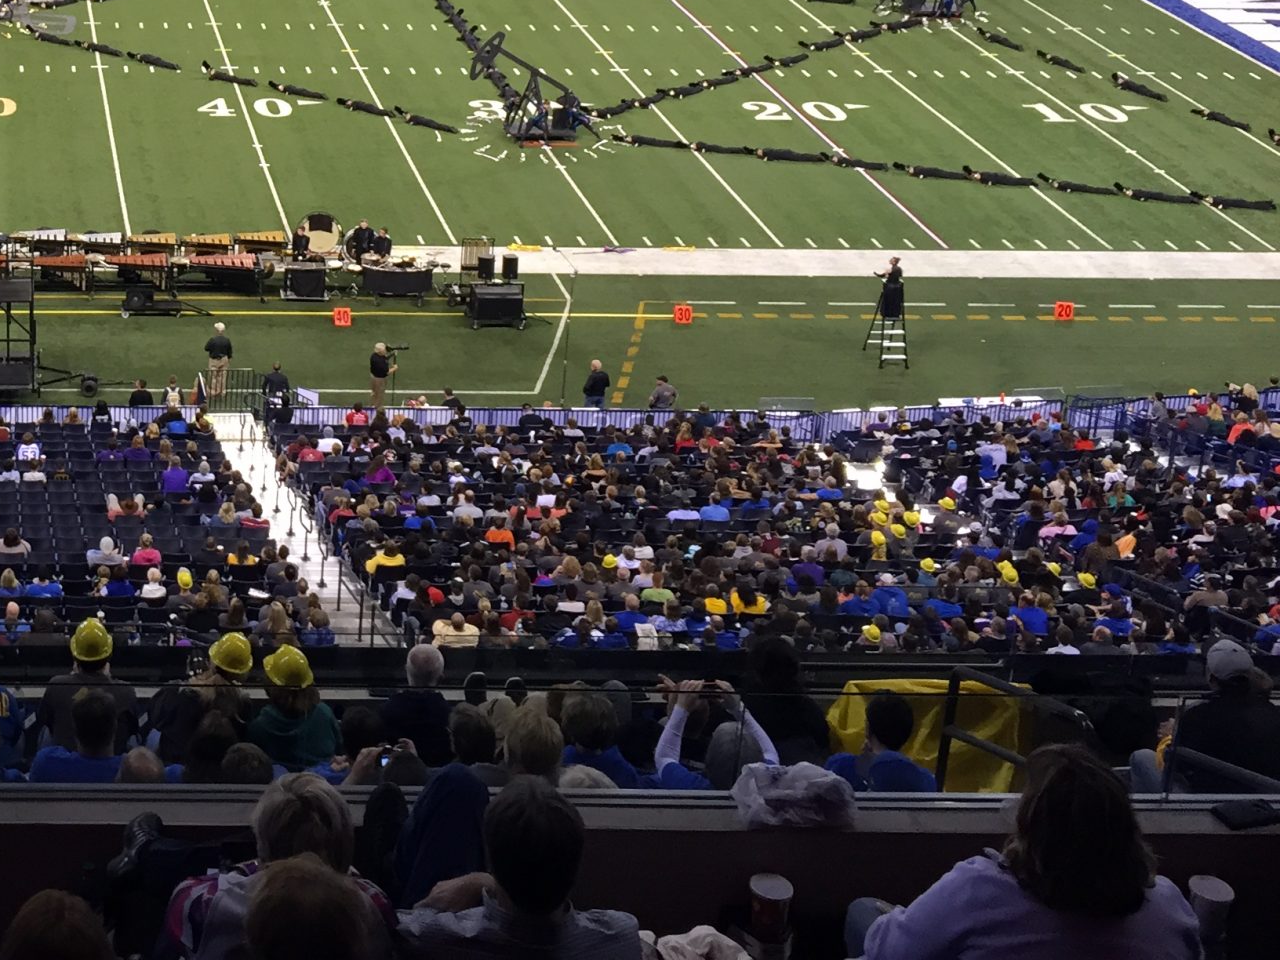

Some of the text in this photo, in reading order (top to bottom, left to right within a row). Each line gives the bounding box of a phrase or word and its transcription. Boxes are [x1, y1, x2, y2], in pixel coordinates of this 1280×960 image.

[196, 97, 293, 118] 40
[741, 101, 848, 122] 20
[1022, 101, 1139, 123] 10
[336, 310, 349, 323] 40
[678, 308, 691, 321] 30
[1058, 304, 1072, 318] 20
